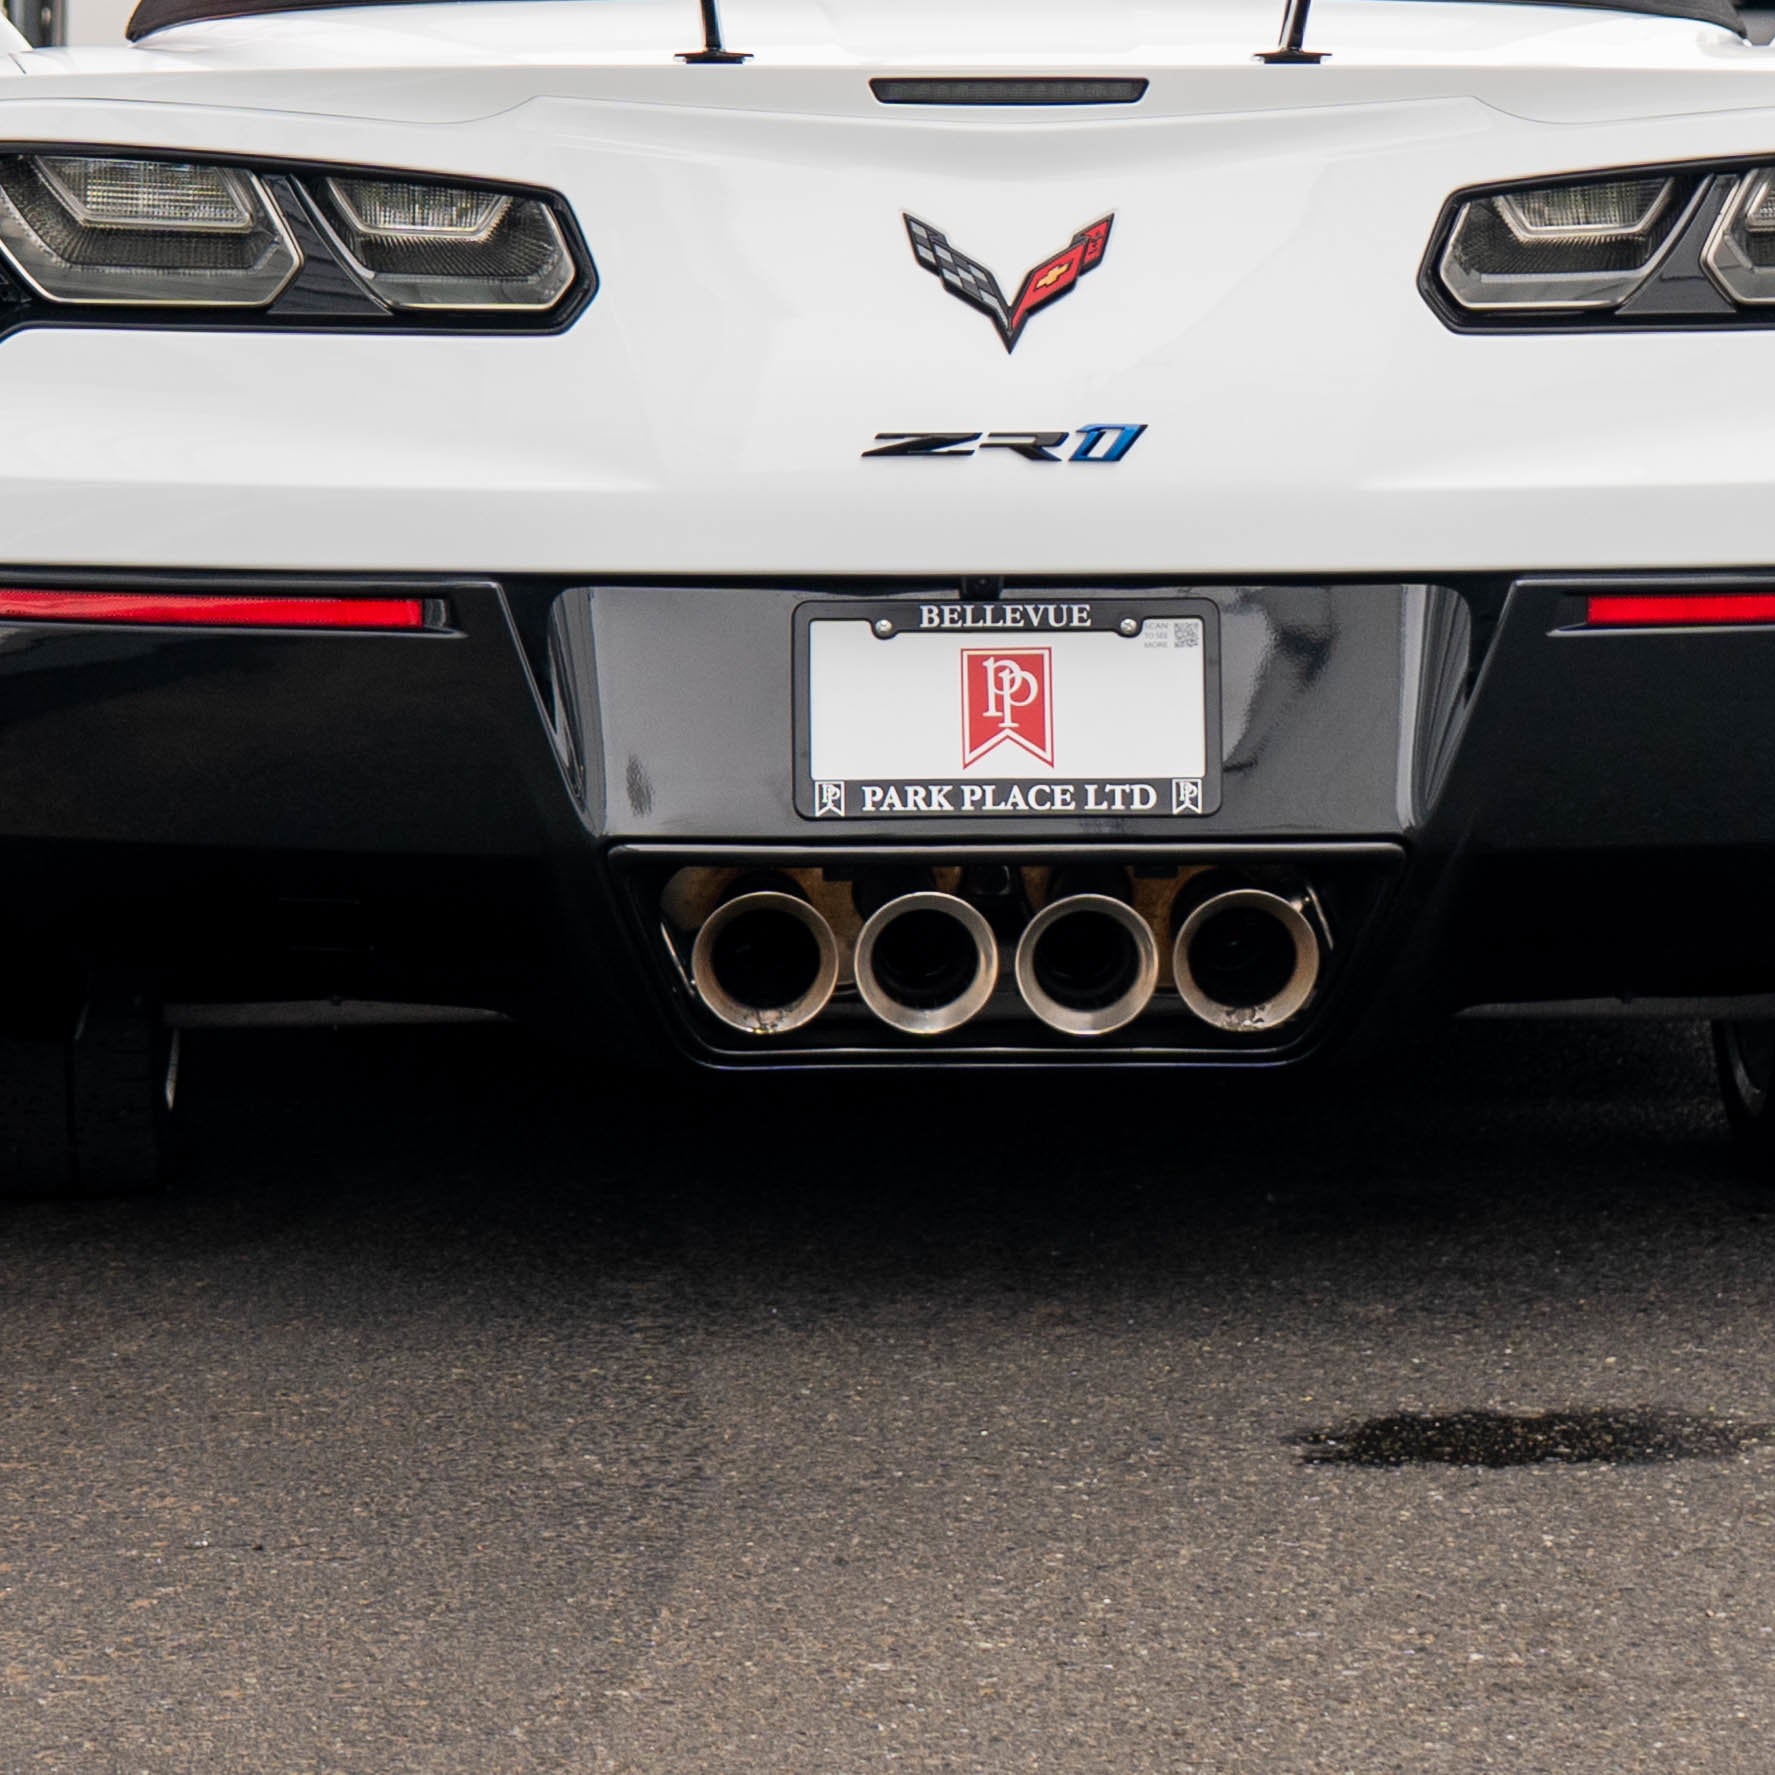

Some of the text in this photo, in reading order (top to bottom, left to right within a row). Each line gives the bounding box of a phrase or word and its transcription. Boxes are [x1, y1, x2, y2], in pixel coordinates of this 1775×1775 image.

[861, 423, 1148, 462] ZR1
[920, 604, 1092, 628] BELLEVUE
[861, 784, 1158, 812] PARK PLACE LTD
